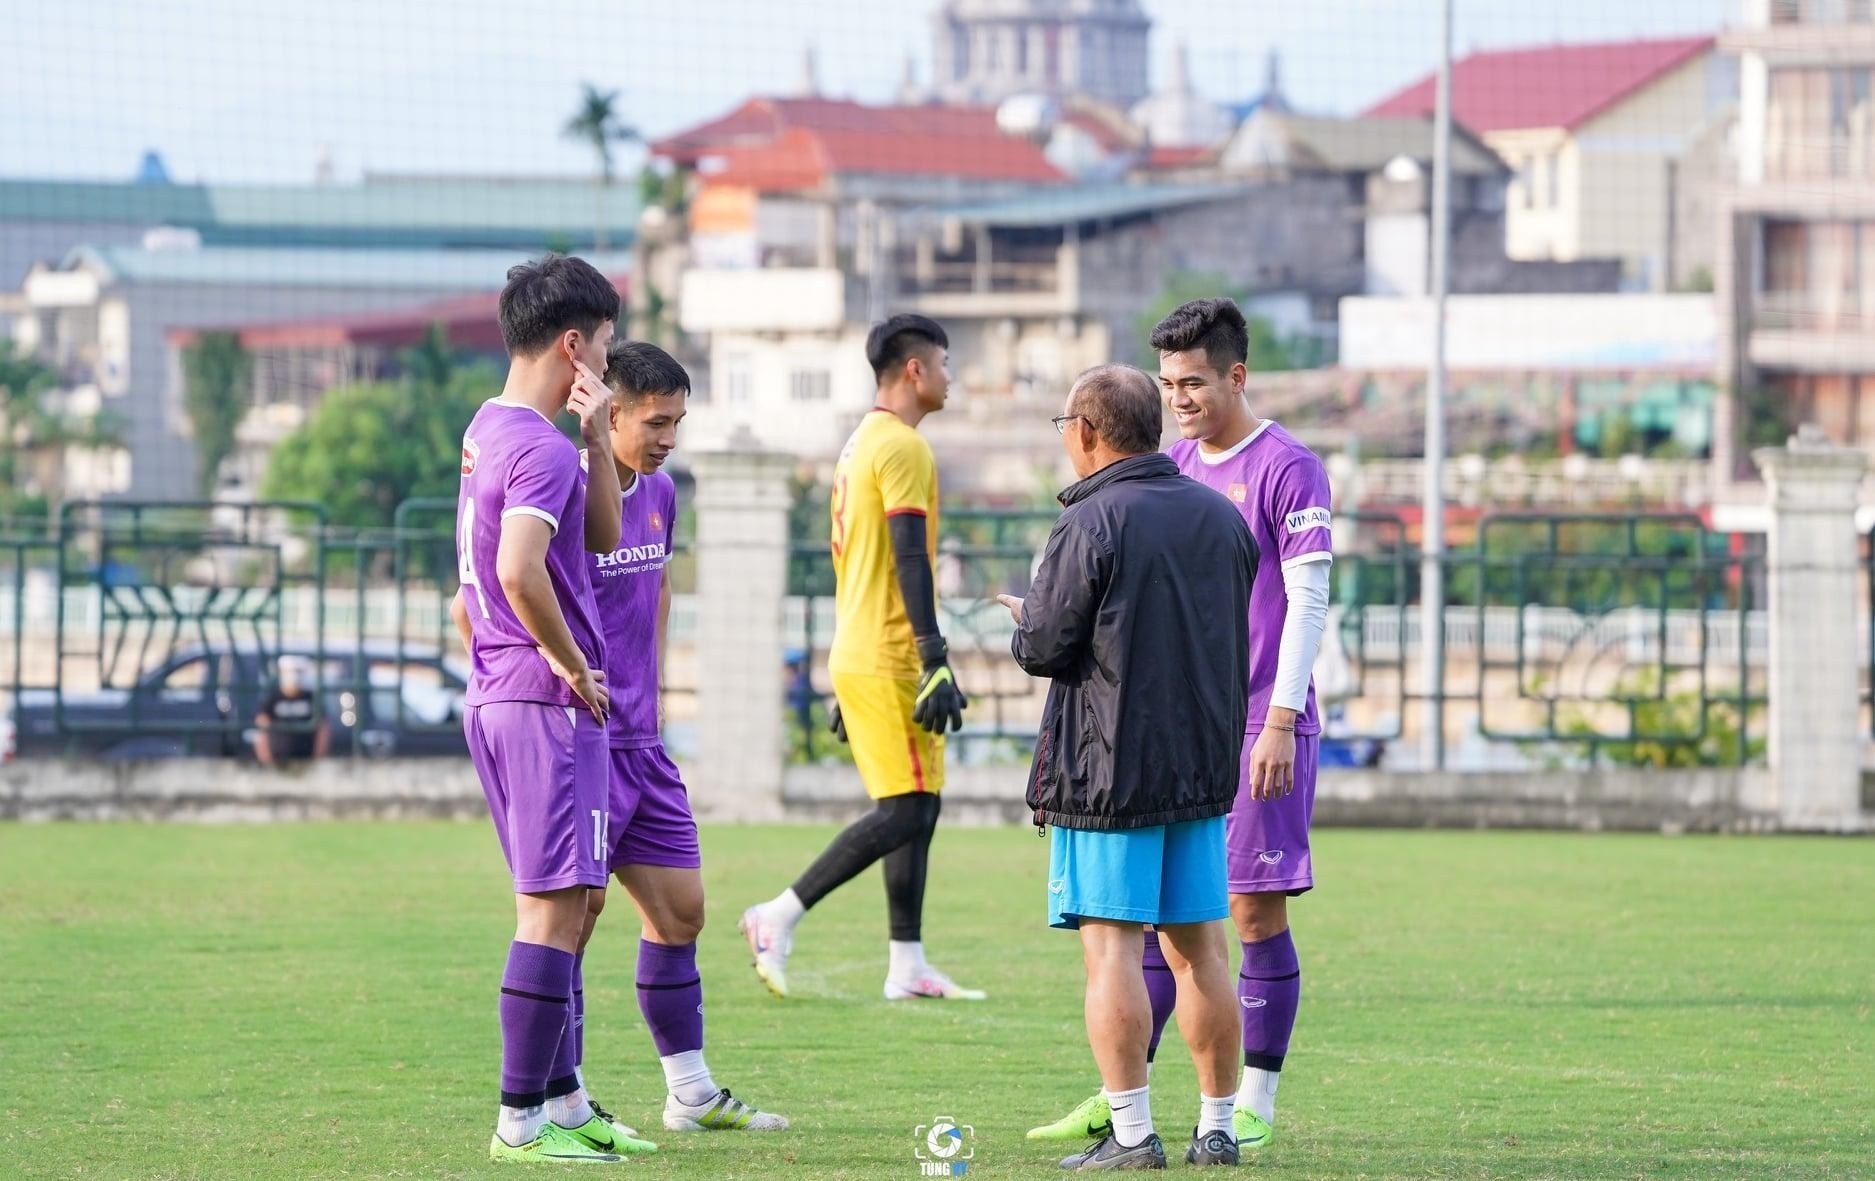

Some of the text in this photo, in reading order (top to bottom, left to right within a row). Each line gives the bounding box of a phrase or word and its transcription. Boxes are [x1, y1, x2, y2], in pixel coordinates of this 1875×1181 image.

[595, 543, 665, 567] HONDA
[600, 570, 617, 578] The
[618, 567, 640, 575] Power
